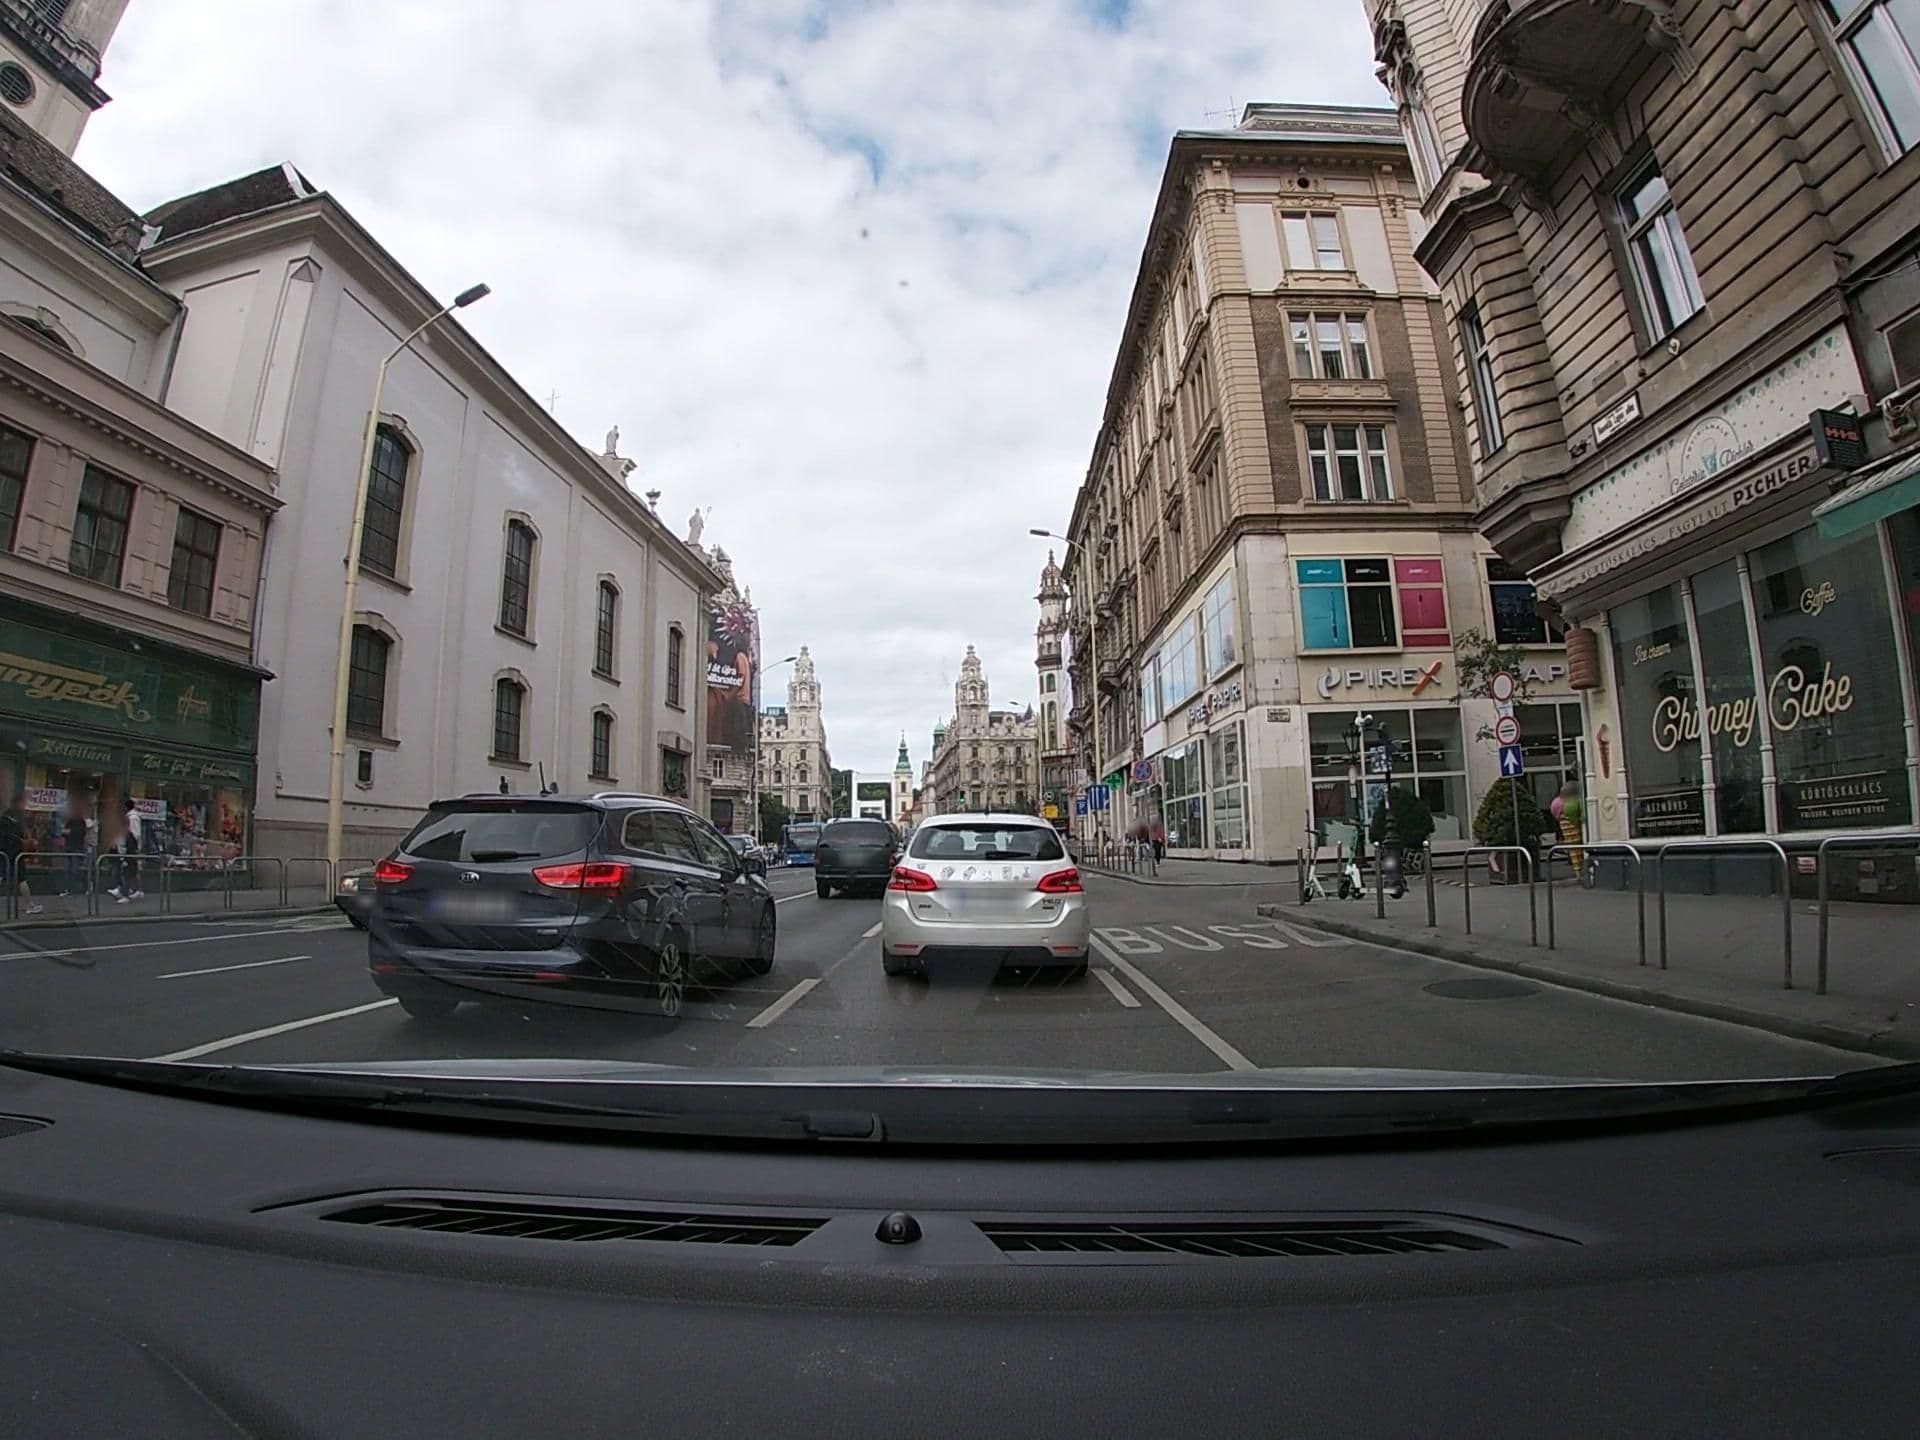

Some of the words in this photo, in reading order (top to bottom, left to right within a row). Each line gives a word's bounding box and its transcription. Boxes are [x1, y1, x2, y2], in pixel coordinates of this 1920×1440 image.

[1731, 454, 1812, 507] PICHLER
[1800, 581, 1837, 617] Coffee
[1344, 659, 1443, 697] PIREX
[1653, 695, 1759, 753] Chimney
[1768, 660, 1854, 732] Cake
